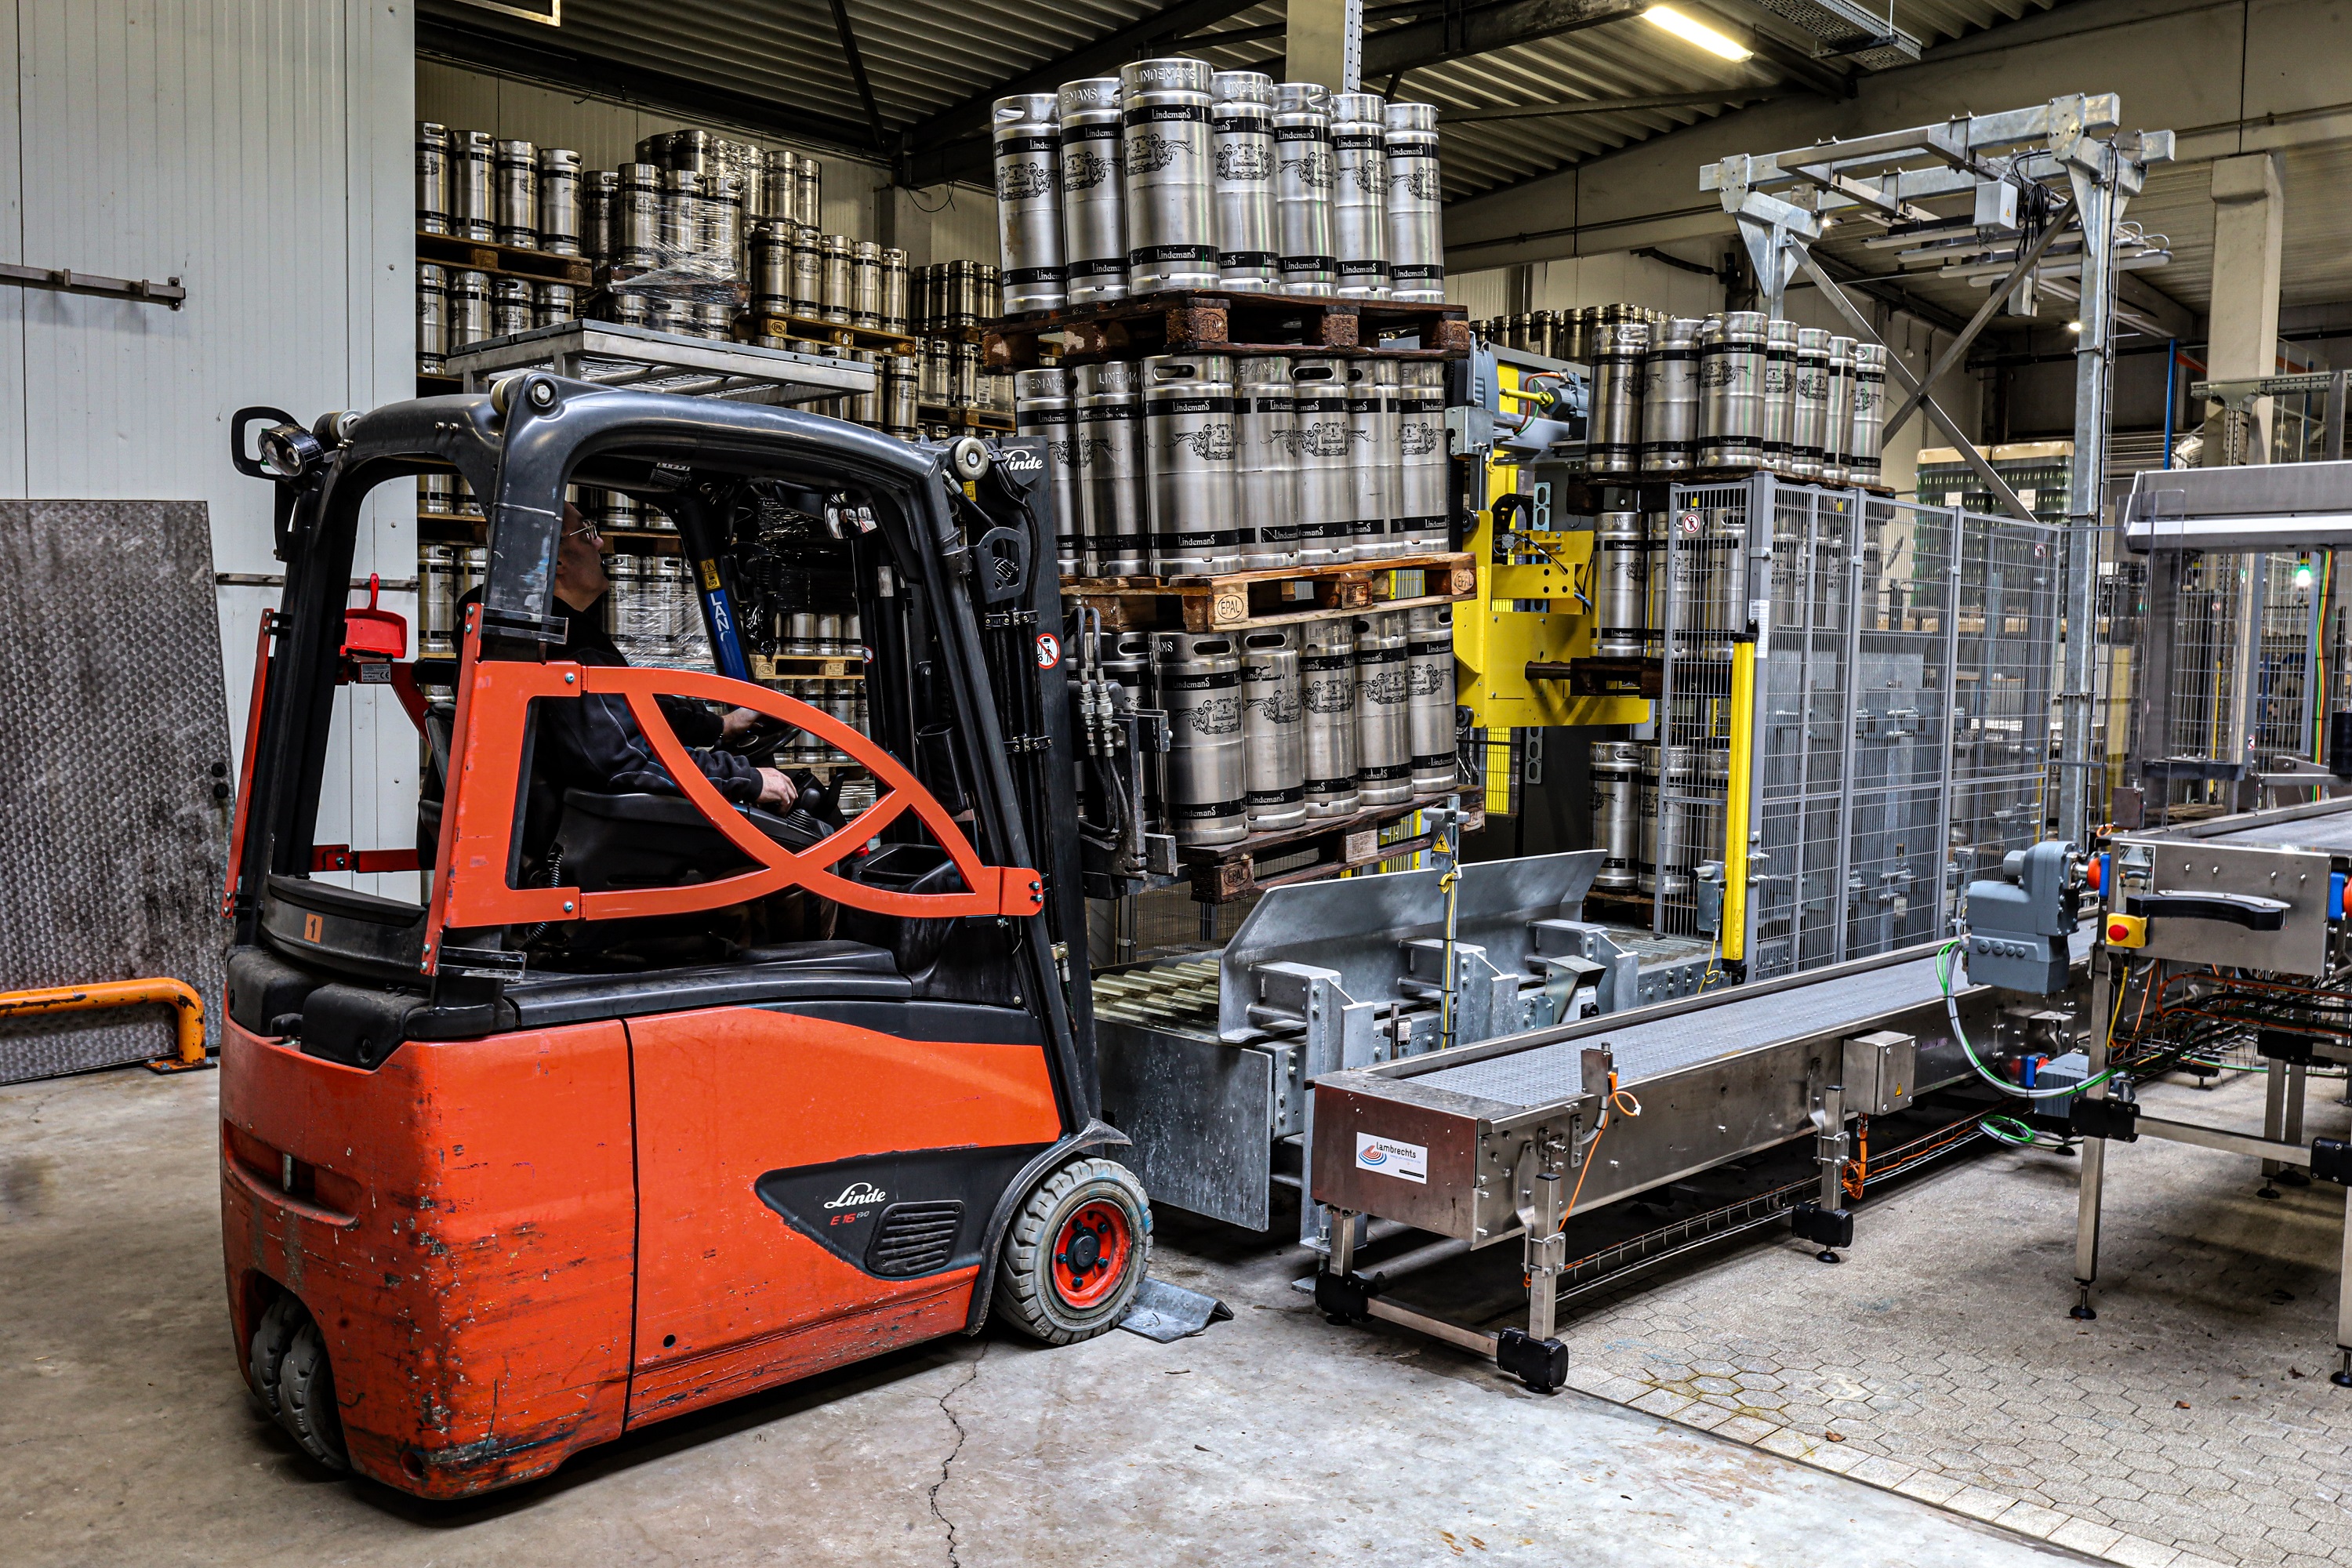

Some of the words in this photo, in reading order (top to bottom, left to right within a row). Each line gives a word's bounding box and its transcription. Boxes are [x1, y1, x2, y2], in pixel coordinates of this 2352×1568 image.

[1221, 600, 1240, 615] EPAL
[310, 918, 317, 939] 1
[1376, 1142, 1417, 1159] lambrechts
[824, 1182, 886, 1209] Linde
[830, 1216, 840, 1225] E
